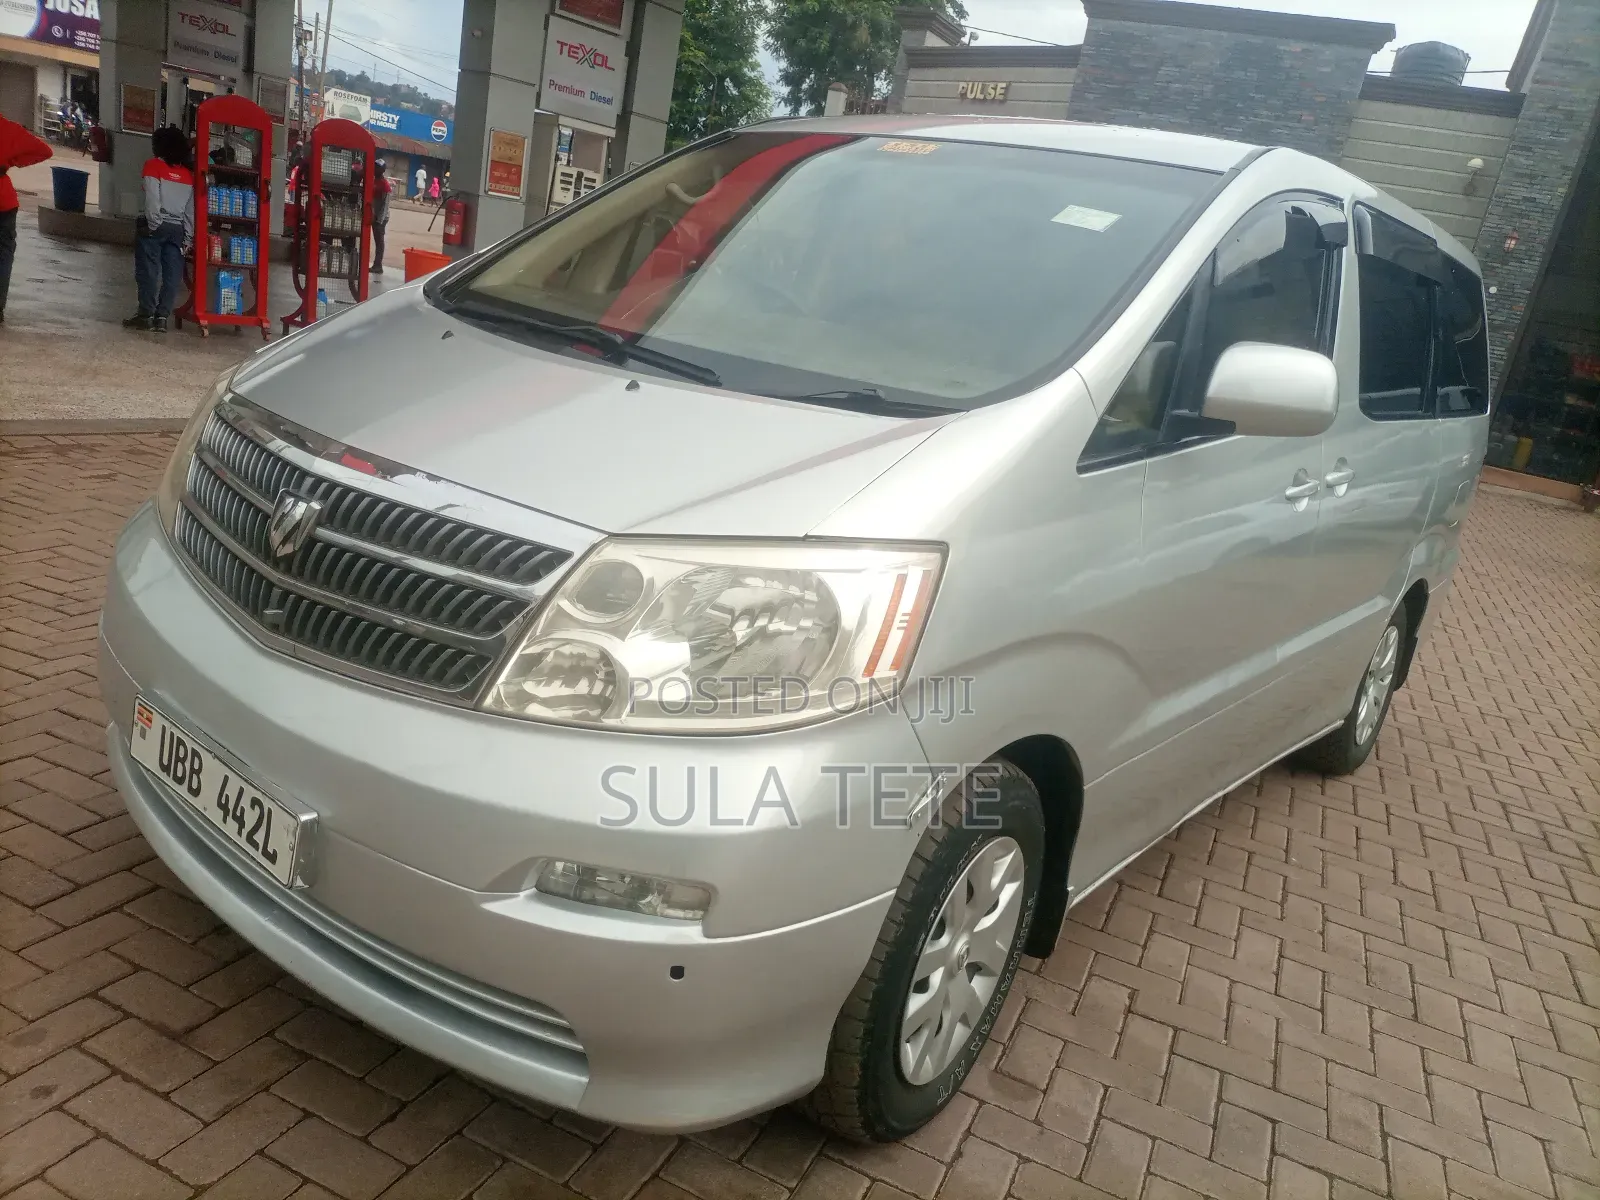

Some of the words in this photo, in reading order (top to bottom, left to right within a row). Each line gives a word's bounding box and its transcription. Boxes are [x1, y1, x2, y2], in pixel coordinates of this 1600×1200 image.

[178, 11, 236, 37] TEXOL
[174, 40, 209, 56] Premium
[214, 50, 237, 63] Diesel
[556, 40, 615, 71] TEXOL
[333, 90, 368, 103] ROSEFOAM
[548, 79, 586, 98] Premium
[589, 90, 614, 106] Diesel
[958, 82, 1007, 100] PULSE
[377, 120, 397, 130] MORE
[158, 724, 203, 798] UBB
[216, 774, 278, 865] 442L
[936, 1059, 965, 1106] A/T
